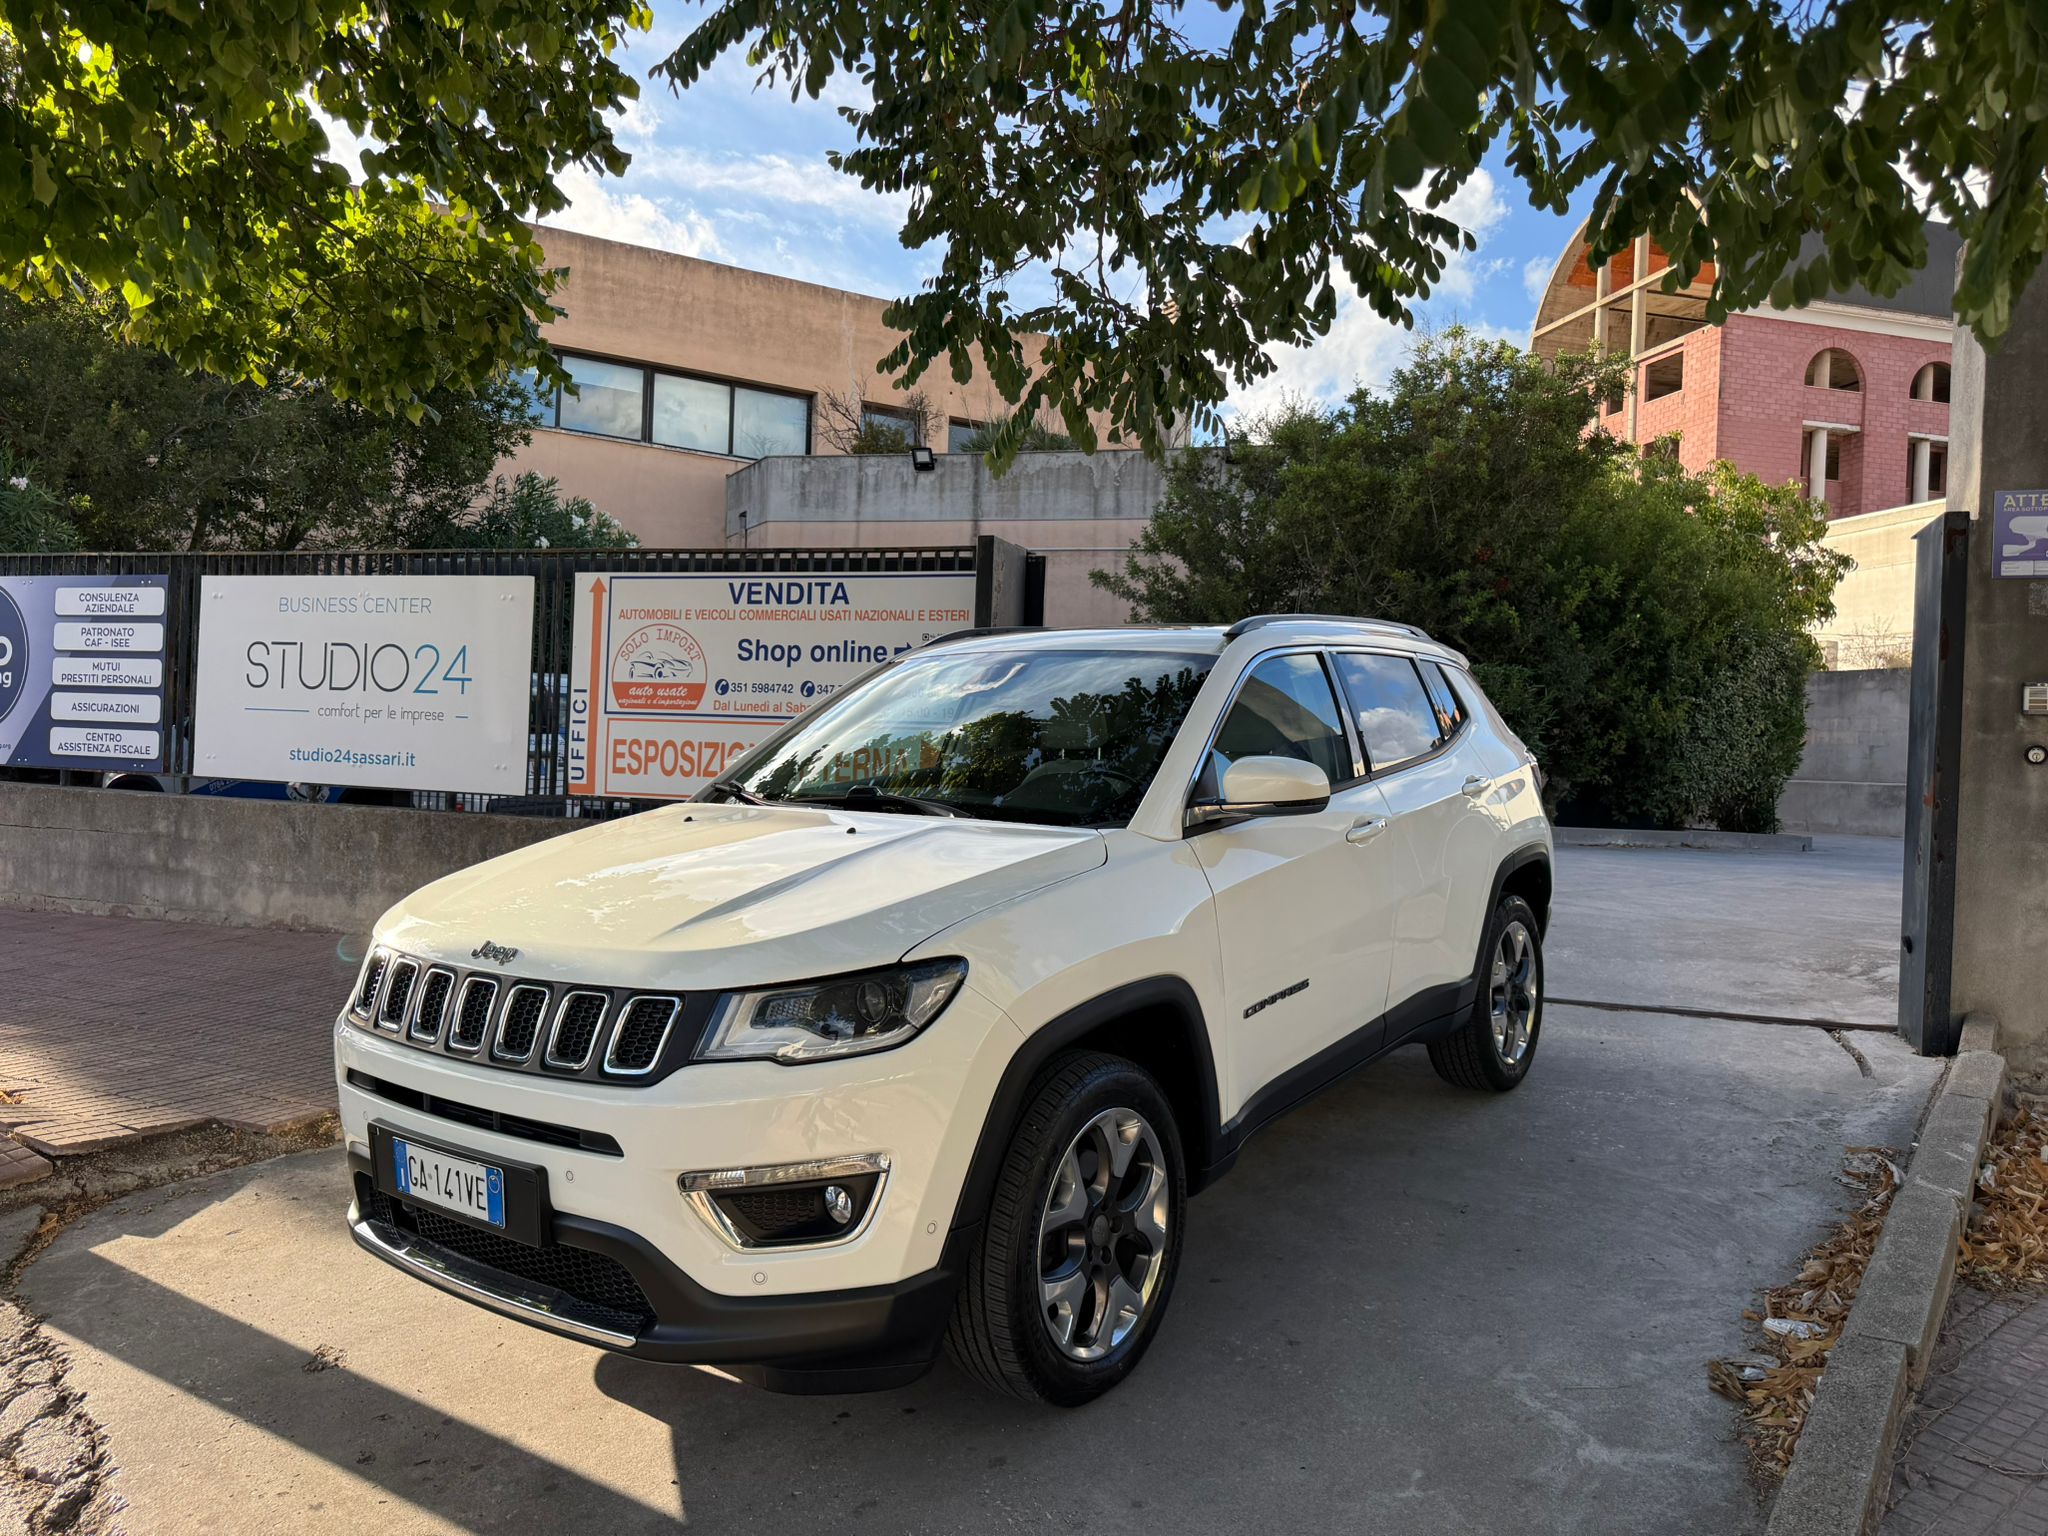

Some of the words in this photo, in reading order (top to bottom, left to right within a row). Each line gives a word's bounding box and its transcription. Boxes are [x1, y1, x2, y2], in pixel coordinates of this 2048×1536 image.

[79, 593, 139, 602] CONSULENZA
[729, 582, 850, 605] VENDITA
[85, 604, 134, 613] AZIENDALE
[279, 597, 358, 613] BUSINESS
[363, 598, 432, 614] CENTER
[618, 609, 682, 620] AUTOMOBILI
[685, 609, 691, 620] E
[694, 609, 736, 621] VEICOLI
[739, 609, 816, 621] COMMERCIALI
[820, 609, 851, 621] USATI
[855, 609, 915, 621] NAZIONALI
[918, 609, 925, 621] E
[928, 609, 970, 621] ESTERI
[81, 628, 134, 637] PATRONATO
[84, 638, 102, 647] CAF
[111, 639, 130, 647] ISEE
[620, 632, 649, 662] SOLO
[655, 628, 702, 661] IMPORT
[738, 639, 801, 667] Shop
[810, 640, 888, 662] online
[92, 662, 120, 671] MUTUI
[246, 641, 472, 694] STUDIO24
[61, 673, 99, 683] PRESTITI
[101, 674, 152, 685] PERSONALI
[628, 685, 654, 696] auto
[656, 686, 689, 697] usate
[730, 682, 748, 692] 351
[751, 683, 794, 693] 5984742
[71, 702, 140, 714] ASSICURAZIONI
[713, 700, 730, 711] Dal
[773, 702, 782, 712] al
[785, 701, 811, 713] Sab
[317, 702, 361, 718] comfort
[364, 707, 383, 724] per
[387, 705, 397, 719] le
[401, 708, 444, 725] imprese
[85, 732, 122, 742] CENTRO
[570, 689, 588, 781] UFFICI
[58, 742, 111, 753] ASSISTENZA
[113, 745, 151, 755] FISCALE
[289, 748, 416, 767] studio24sassari.it
[612, 738, 754, 778] ESPOSIZI
[471, 940, 519, 966] Jeep
[408, 1155, 428, 1191] GA
[434, 1163, 487, 1211] 141VE
